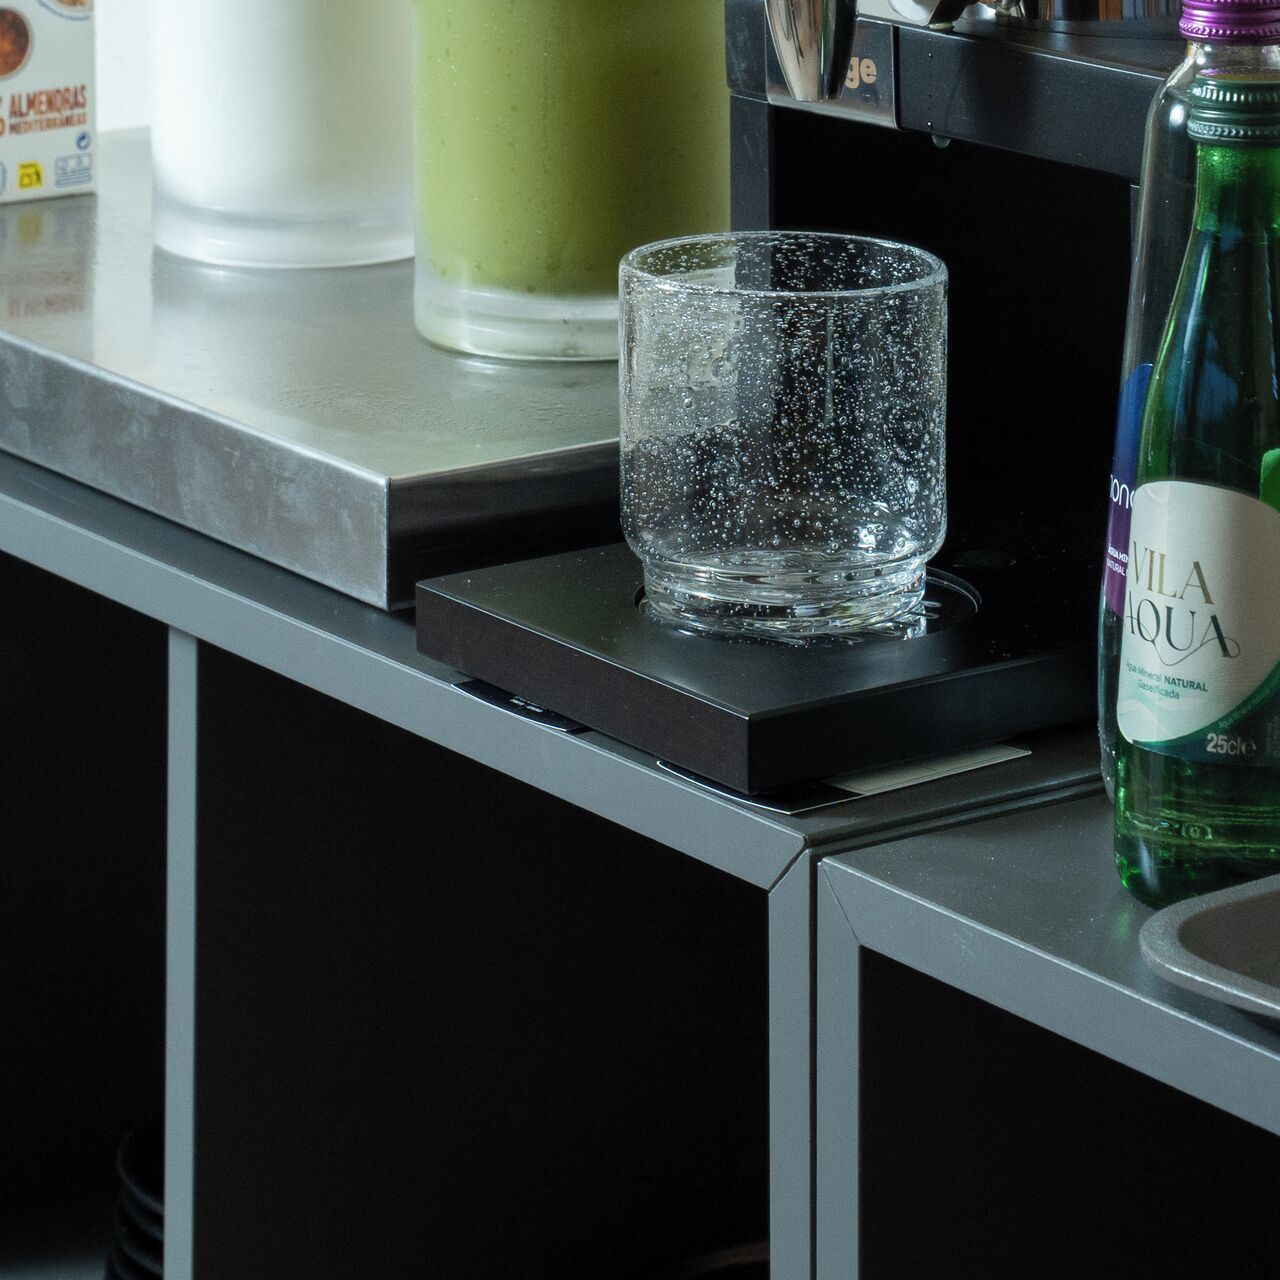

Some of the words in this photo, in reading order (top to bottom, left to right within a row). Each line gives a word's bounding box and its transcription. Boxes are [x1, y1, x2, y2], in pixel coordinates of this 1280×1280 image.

[1132, 540, 1214, 605] VILA
[1125, 590, 1241, 667] AQUA
[1164, 675, 1208, 692] NATURAL
